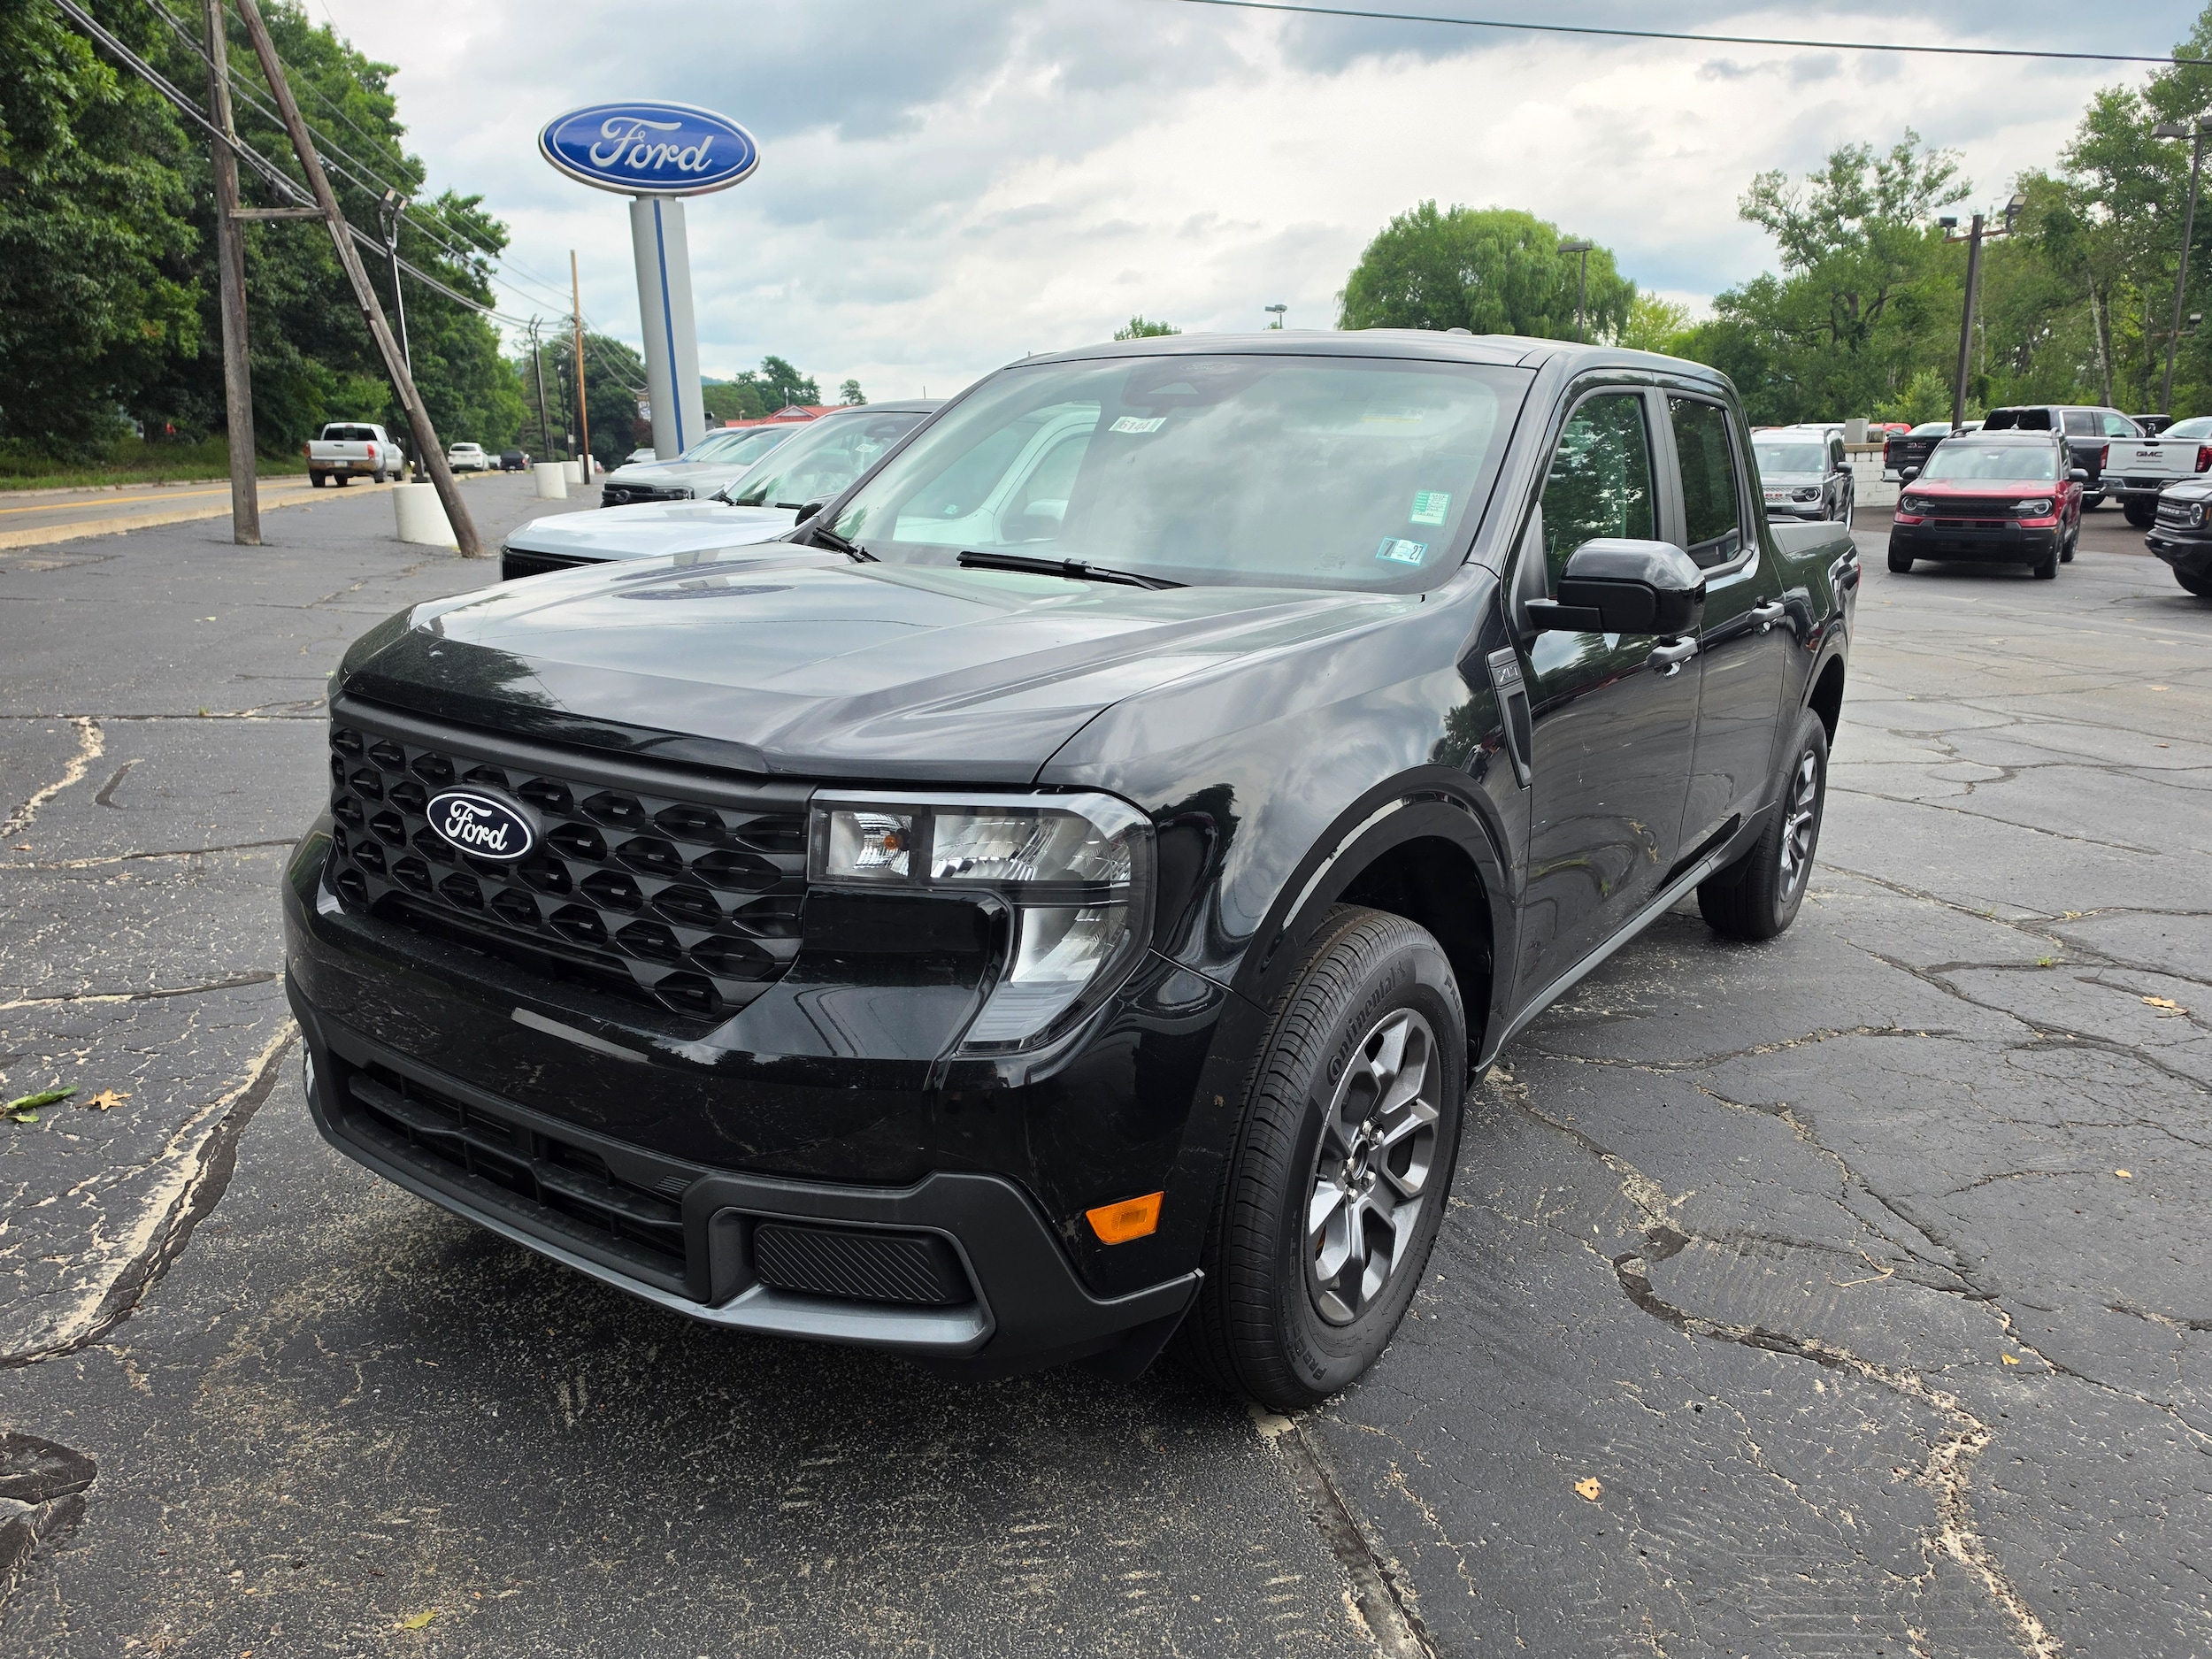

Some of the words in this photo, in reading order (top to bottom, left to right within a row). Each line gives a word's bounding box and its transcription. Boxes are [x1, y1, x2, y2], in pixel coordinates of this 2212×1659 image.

[589, 116, 715, 173] Ford
[1119, 420, 1151, 431] 6144
[1383, 540, 1395, 557] 7
[1409, 544, 1424, 561] 27
[445, 800, 509, 851] Ford
[1327, 966, 1397, 1088] Continental
